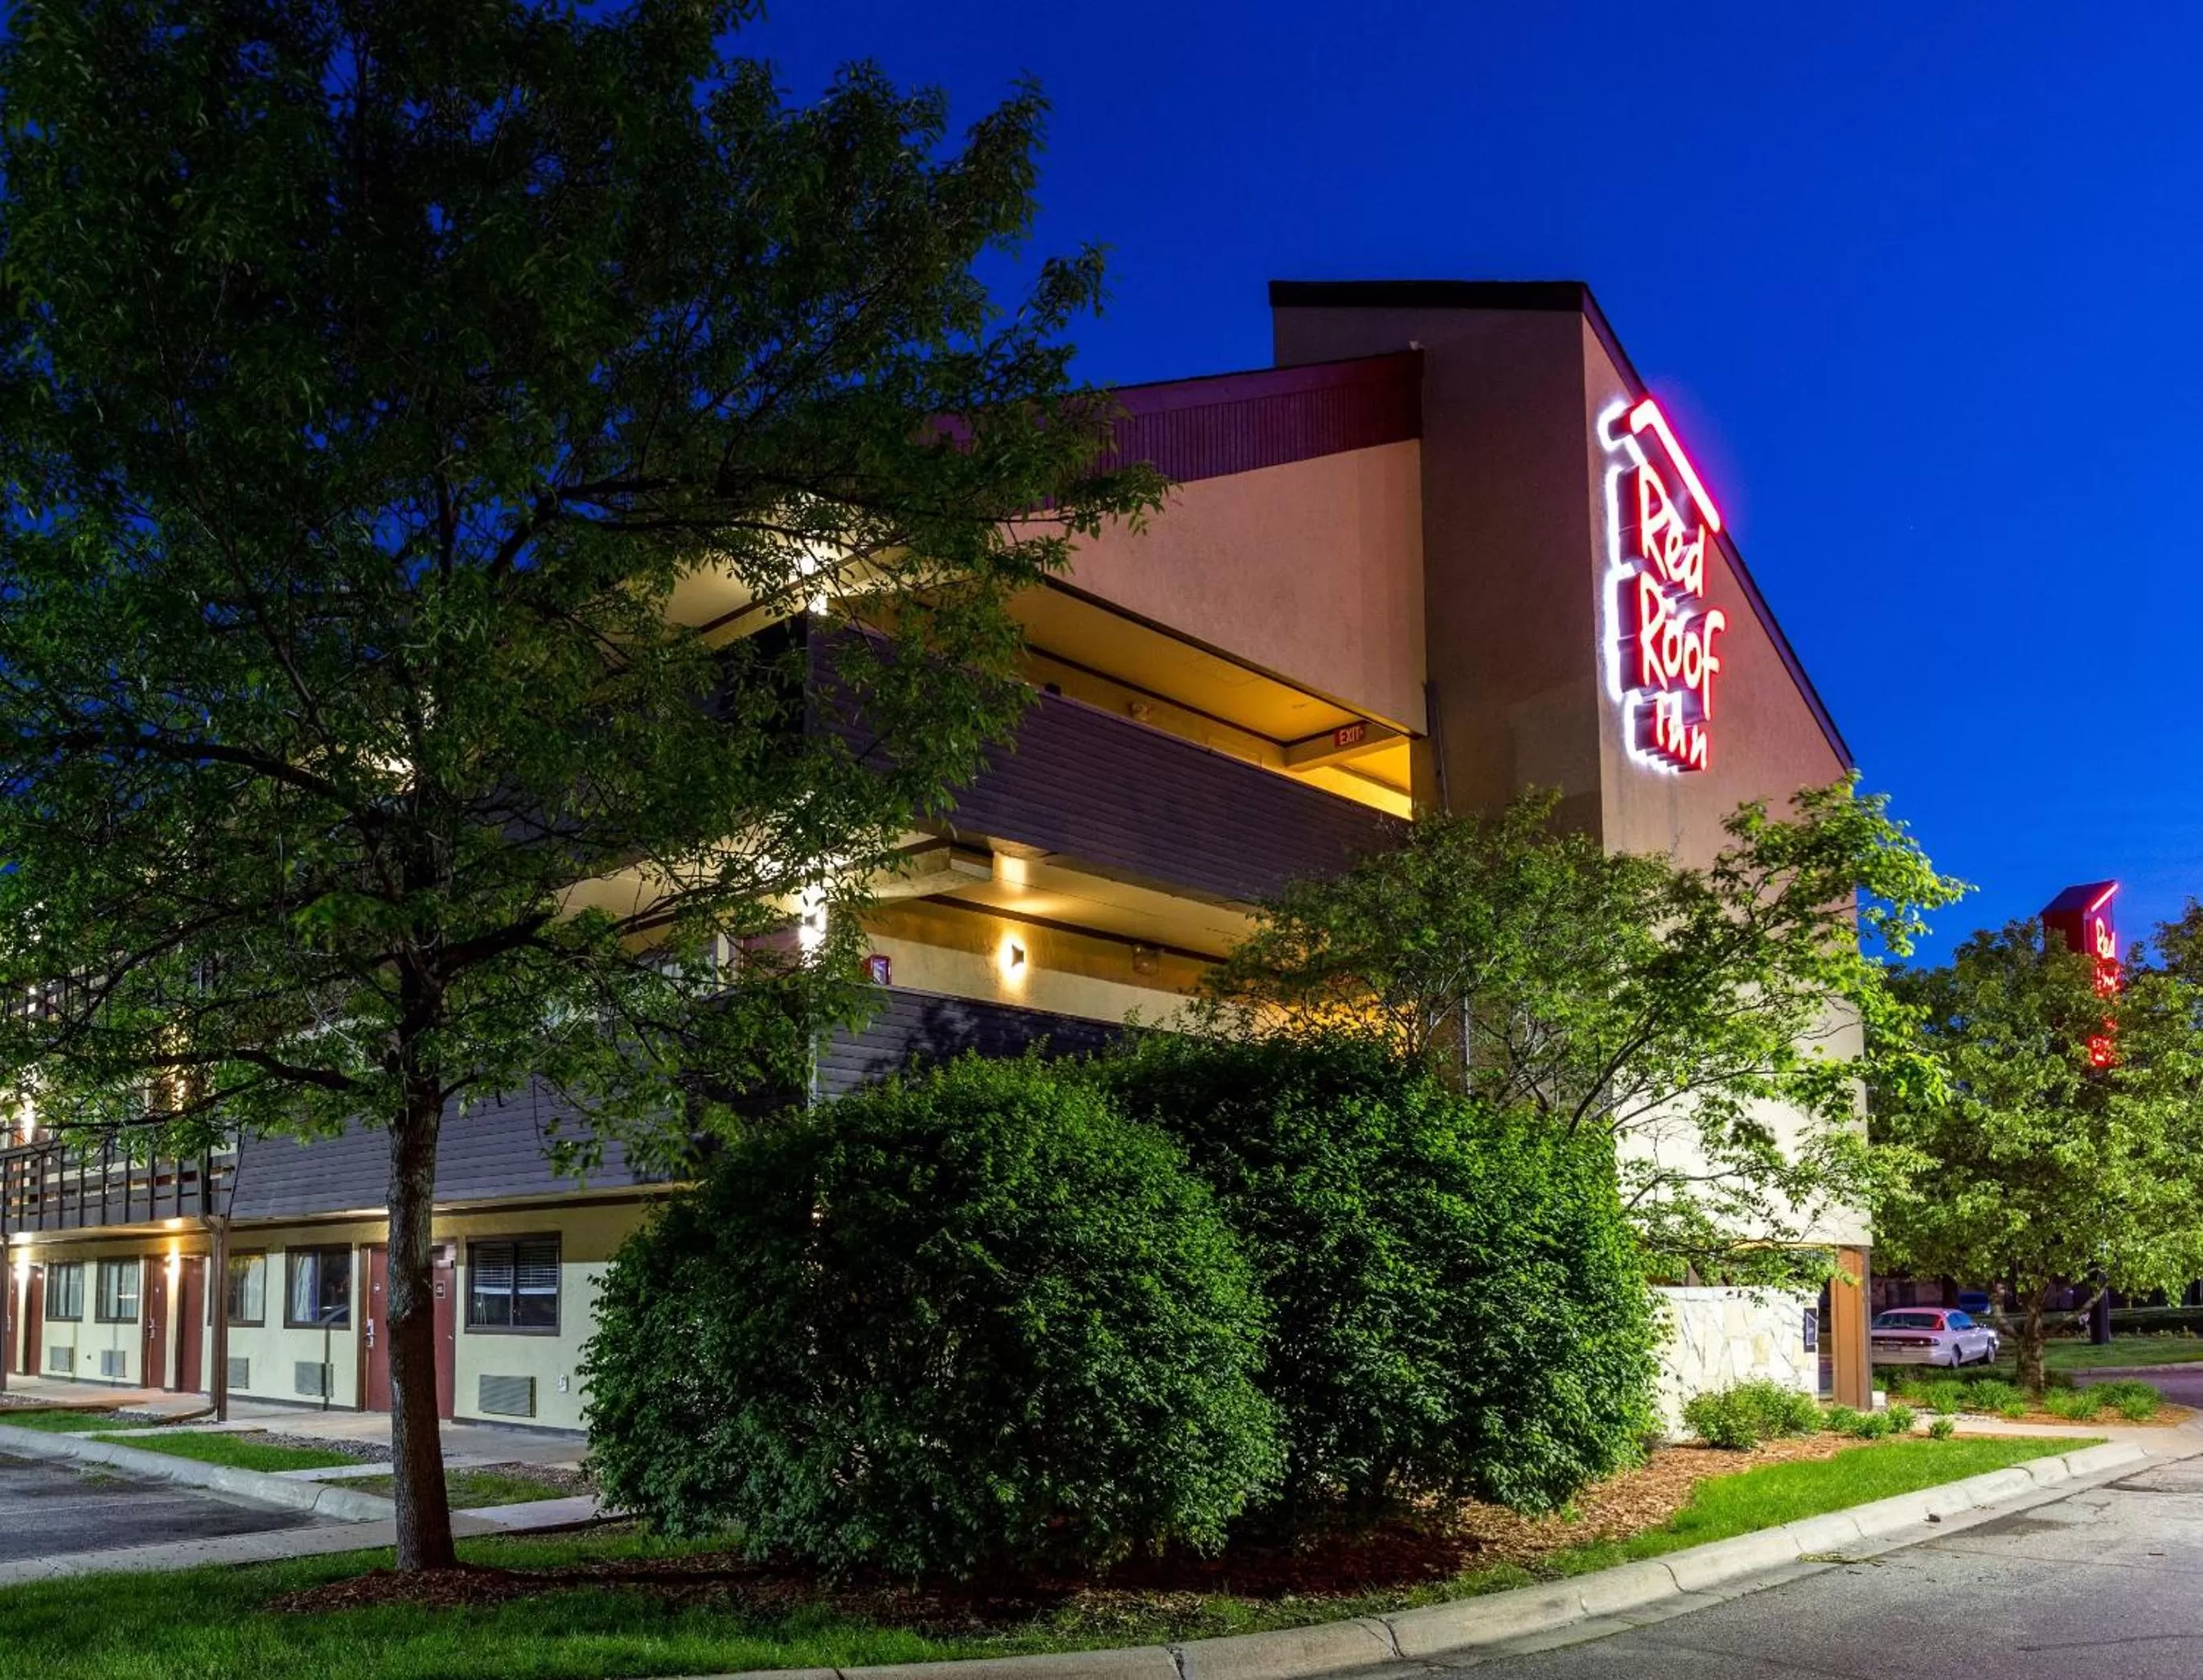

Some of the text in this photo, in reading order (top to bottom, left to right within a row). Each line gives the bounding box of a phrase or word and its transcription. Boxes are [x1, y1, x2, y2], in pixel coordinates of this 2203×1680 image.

[1639, 463, 1706, 598] Red
[1639, 572, 1726, 722] Roof
[1339, 726, 1360, 746] EXIT
[1655, 698, 1708, 771] Inn
